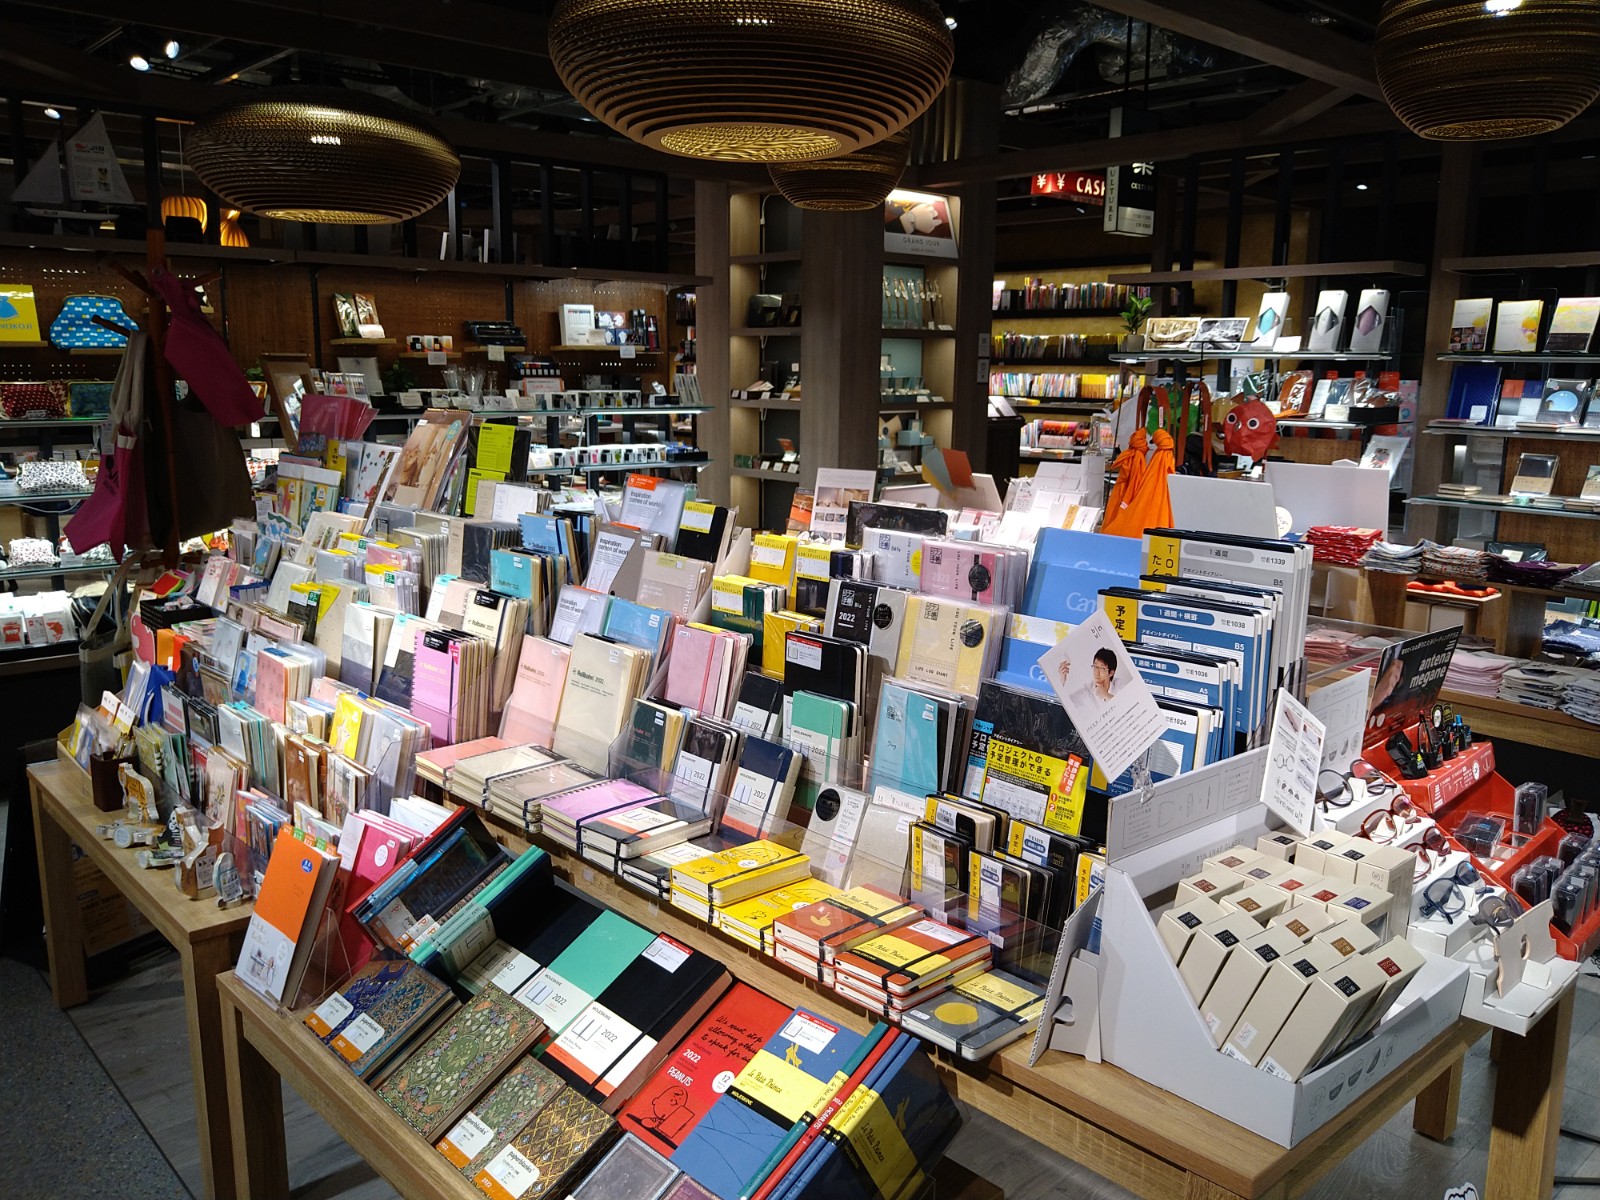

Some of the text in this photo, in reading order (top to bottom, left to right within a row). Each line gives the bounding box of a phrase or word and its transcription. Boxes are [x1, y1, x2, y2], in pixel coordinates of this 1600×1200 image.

[1273, 578, 1285, 587] B5
[838, 611, 856, 623] 2022
[1233, 642, 1245, 652] B5
[1418, 650, 1452, 673] antena
[1409, 665, 1447, 690] megane
[1198, 687, 1209, 695] A5
[750, 720, 763, 730] 2022
[811, 745, 826, 757] 2022
[991, 742, 1043, 764] プロジェクトの
[989, 750, 1052, 777] 予定管理ができる
[693, 769, 706, 781] 2022
[753, 788, 767, 801] 2022
[851, 949, 877, 961] MOLESKINE
[876, 944, 891, 953] Petit
[890, 950, 910, 962] Prince
[544, 973, 563, 987] MOLESKINE
[551, 993, 568, 1007] 2022
[979, 984, 994, 995] Petit
[995, 991, 1016, 1005] Prince
[592, 1005, 612, 1021] MOLESKINE
[600, 1028, 619, 1043] 2022
[708, 1026, 739, 1045] allowing
[747, 1029, 764, 1043] stop
[682, 1048, 702, 1064] 2022
[708, 1038, 729, 1052] speak
[729, 1048, 741, 1061] for
[666, 1065, 694, 1088] PEANUTS
[721, 1073, 732, 1083] 12
[747, 1069, 783, 1094] Le Petit Prince
[731, 1089, 754, 1106] MOLESKINE
[811, 1106, 836, 1131] PEANUTS
[507, 1150, 533, 1174] paperblanks
[481, 1177, 493, 1188] 2022
